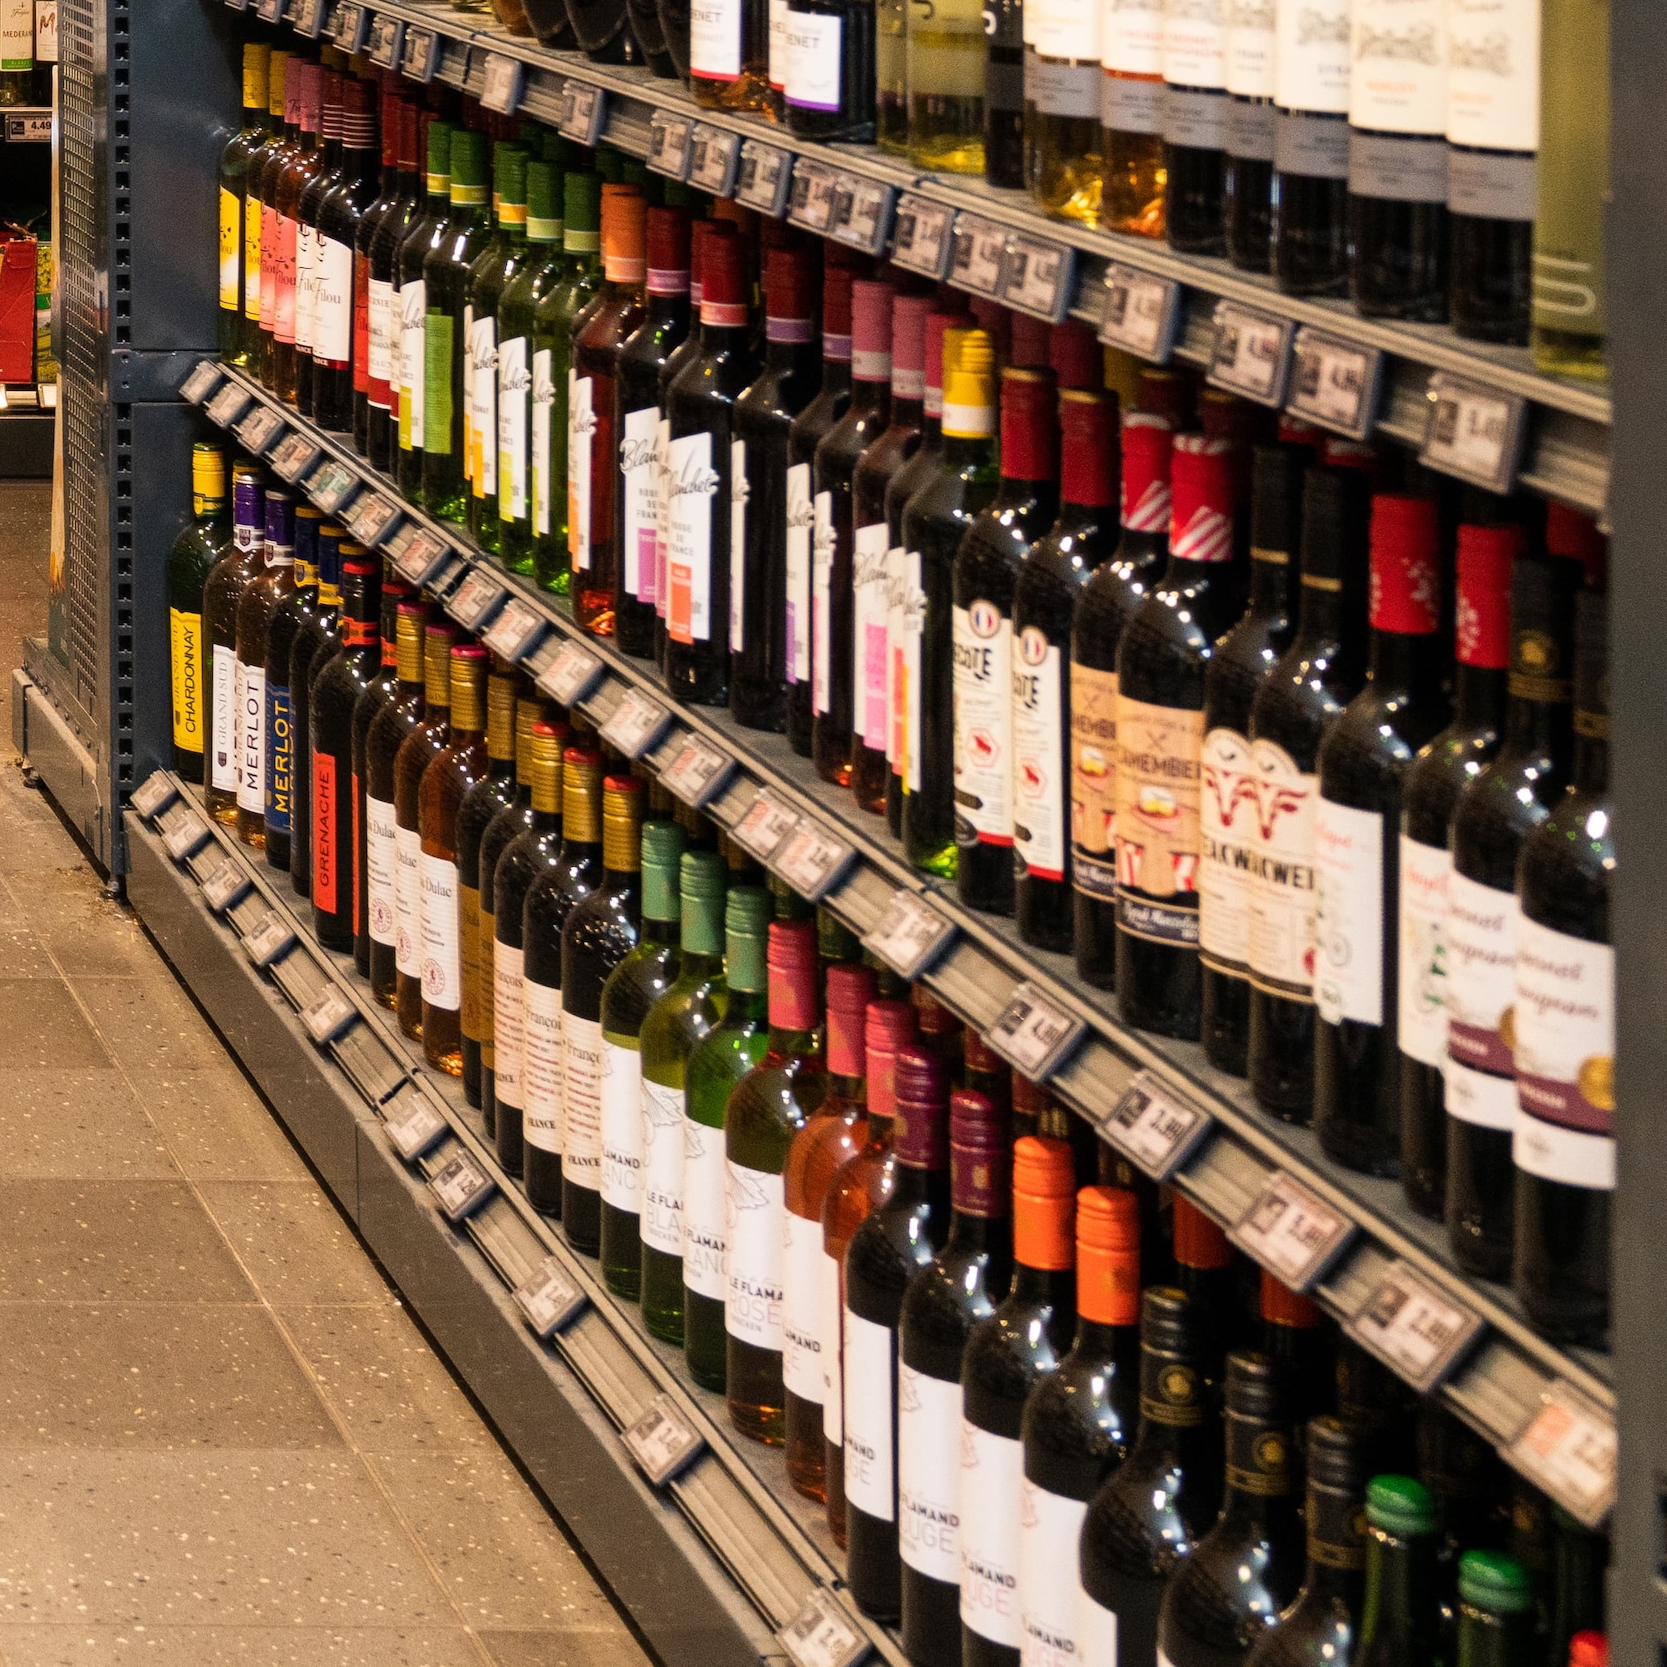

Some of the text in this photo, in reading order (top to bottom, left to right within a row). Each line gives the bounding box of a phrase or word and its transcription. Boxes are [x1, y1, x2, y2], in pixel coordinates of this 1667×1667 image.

[183, 625, 199, 734] CHARDONNAY
[217, 692, 228, 746] GRAND
[247, 681, 260, 791] MERLOT
[274, 703, 289, 815] MERLOT
[319, 772, 331, 889] GRENACHE
[425, 875, 452, 898] Dulac
[528, 1117, 556, 1129] FRANCE
[568, 1155, 602, 1168] FRANCE
